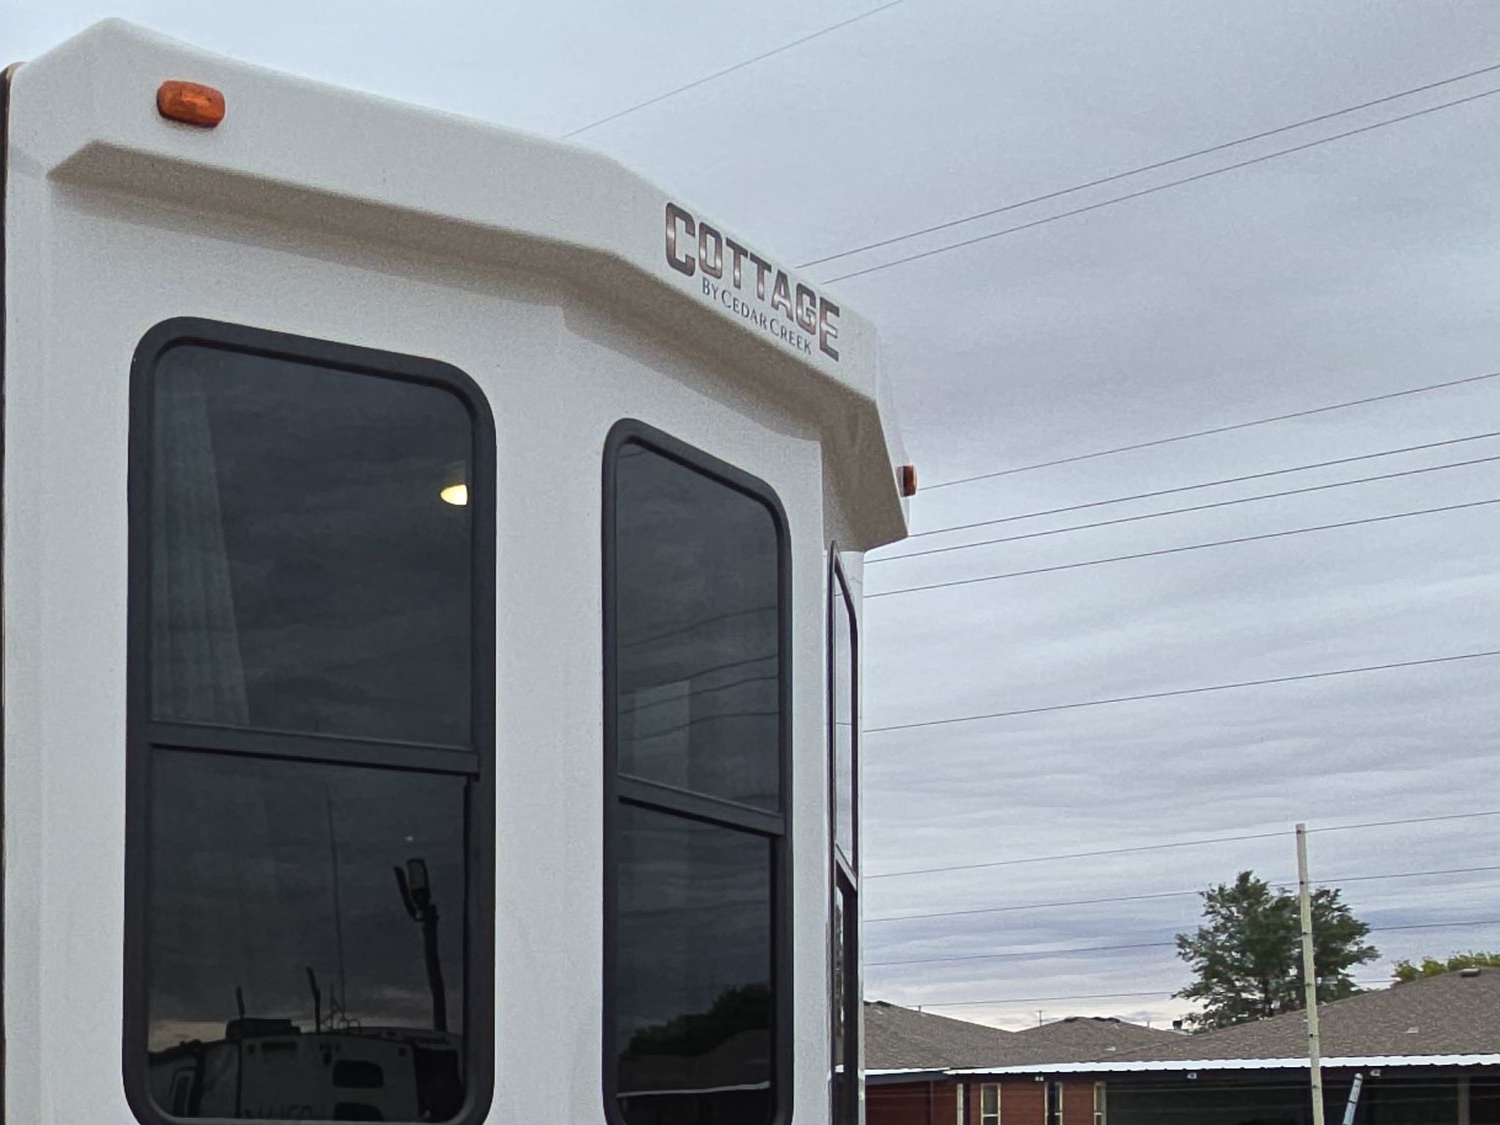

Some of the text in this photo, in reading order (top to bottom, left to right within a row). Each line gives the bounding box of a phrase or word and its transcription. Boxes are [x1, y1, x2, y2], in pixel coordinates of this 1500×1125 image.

[665, 202, 840, 362] COTTAGE
[702, 278, 812, 355] BY CEDAR CREEK
